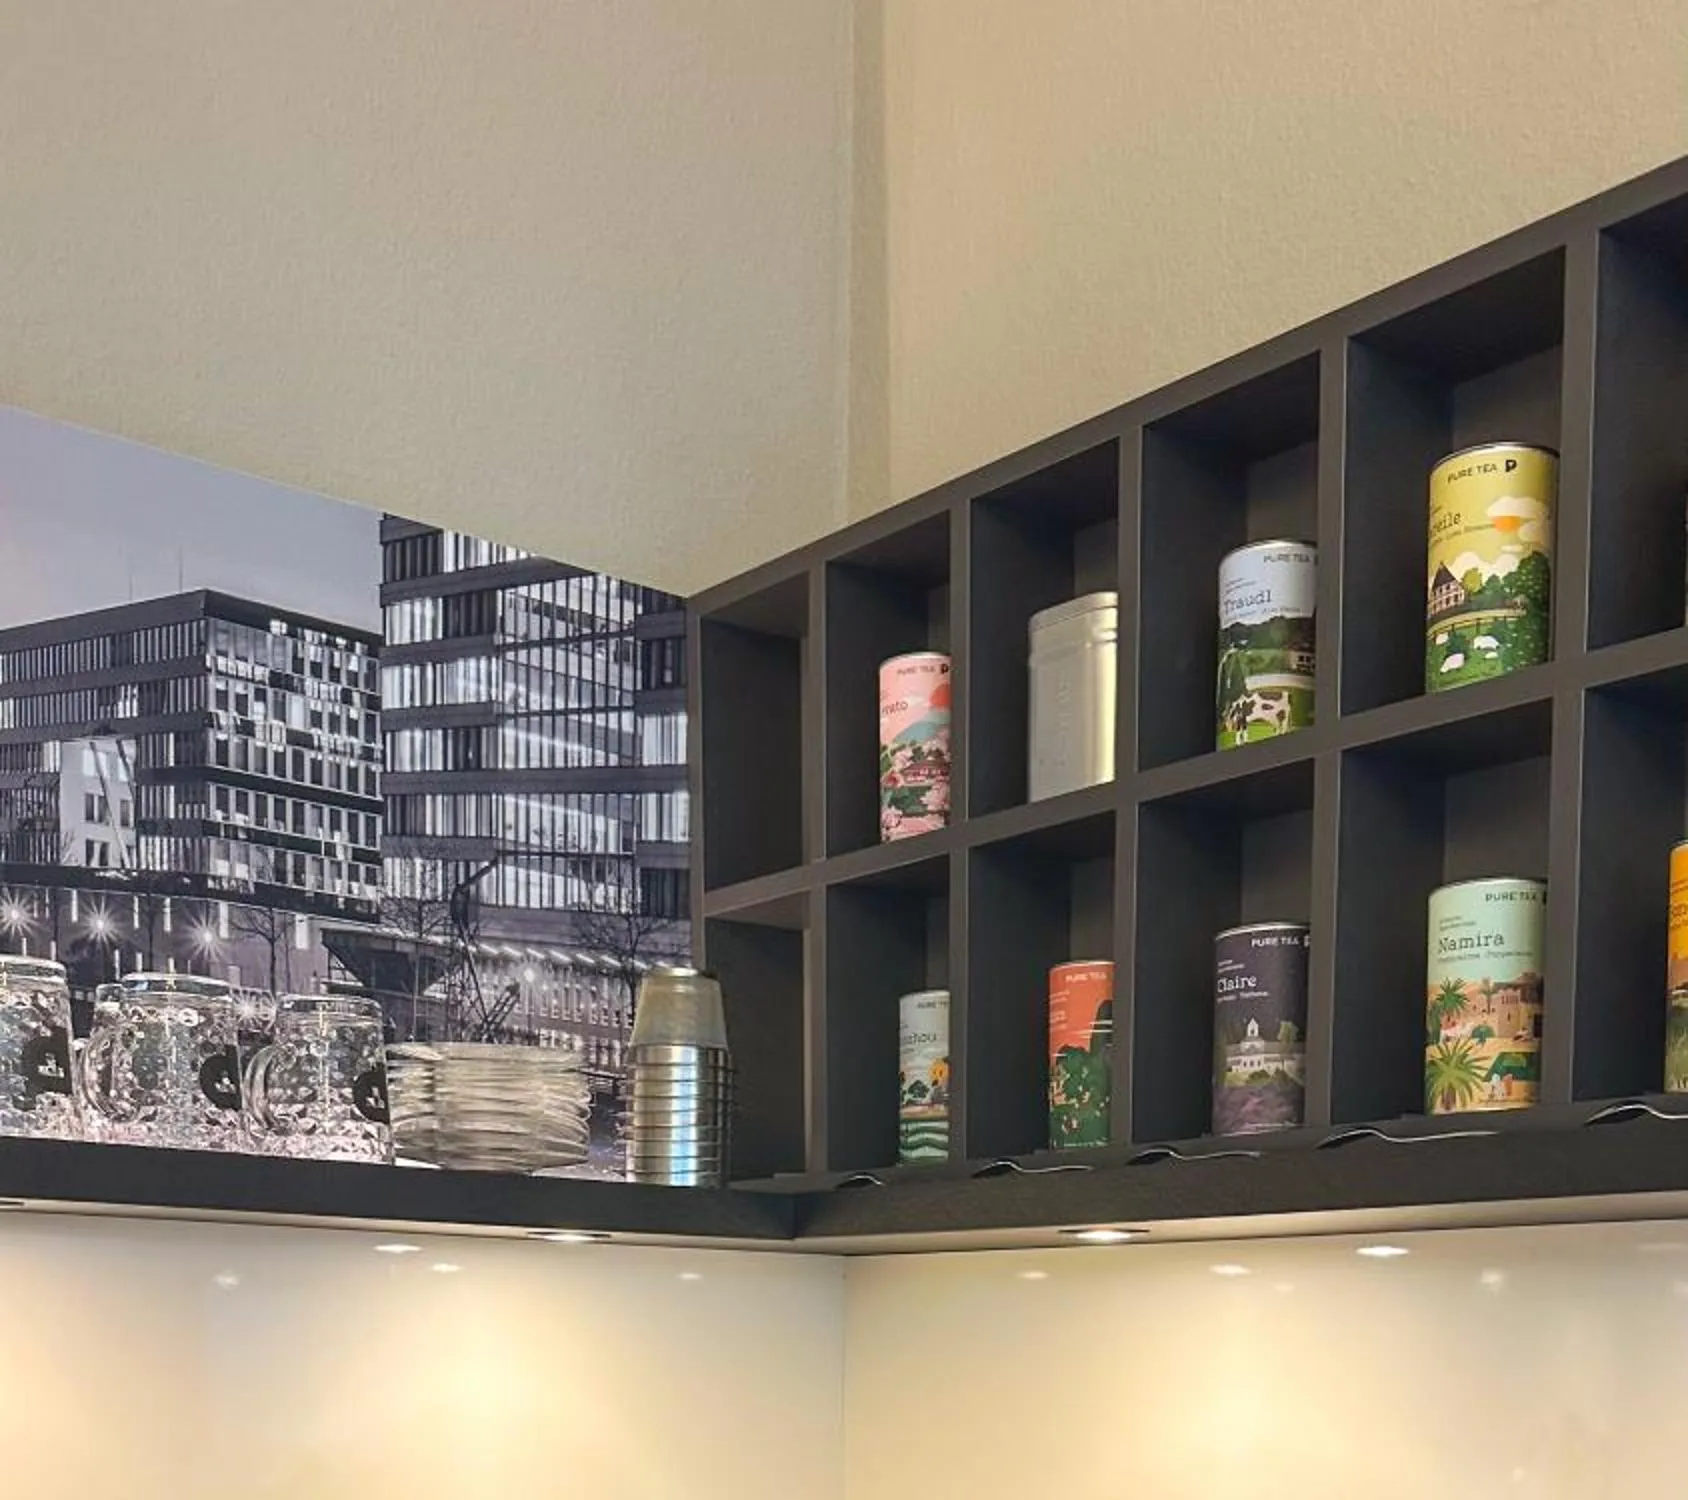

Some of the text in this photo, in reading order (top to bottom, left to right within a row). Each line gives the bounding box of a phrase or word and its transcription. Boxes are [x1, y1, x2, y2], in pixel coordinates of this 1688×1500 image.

[1447, 467, 1473, 484] PURE
[1476, 463, 1498, 475] TEA
[1223, 589, 1271, 616] Traudl
[1485, 891, 1517, 902] PURE
[1519, 891, 1537, 901] TEA
[1251, 937, 1279, 948] PURE
[1281, 936, 1300, 946] TEA
[1438, 933, 1505, 953] Namira
[1217, 975, 1258, 993] Claire
